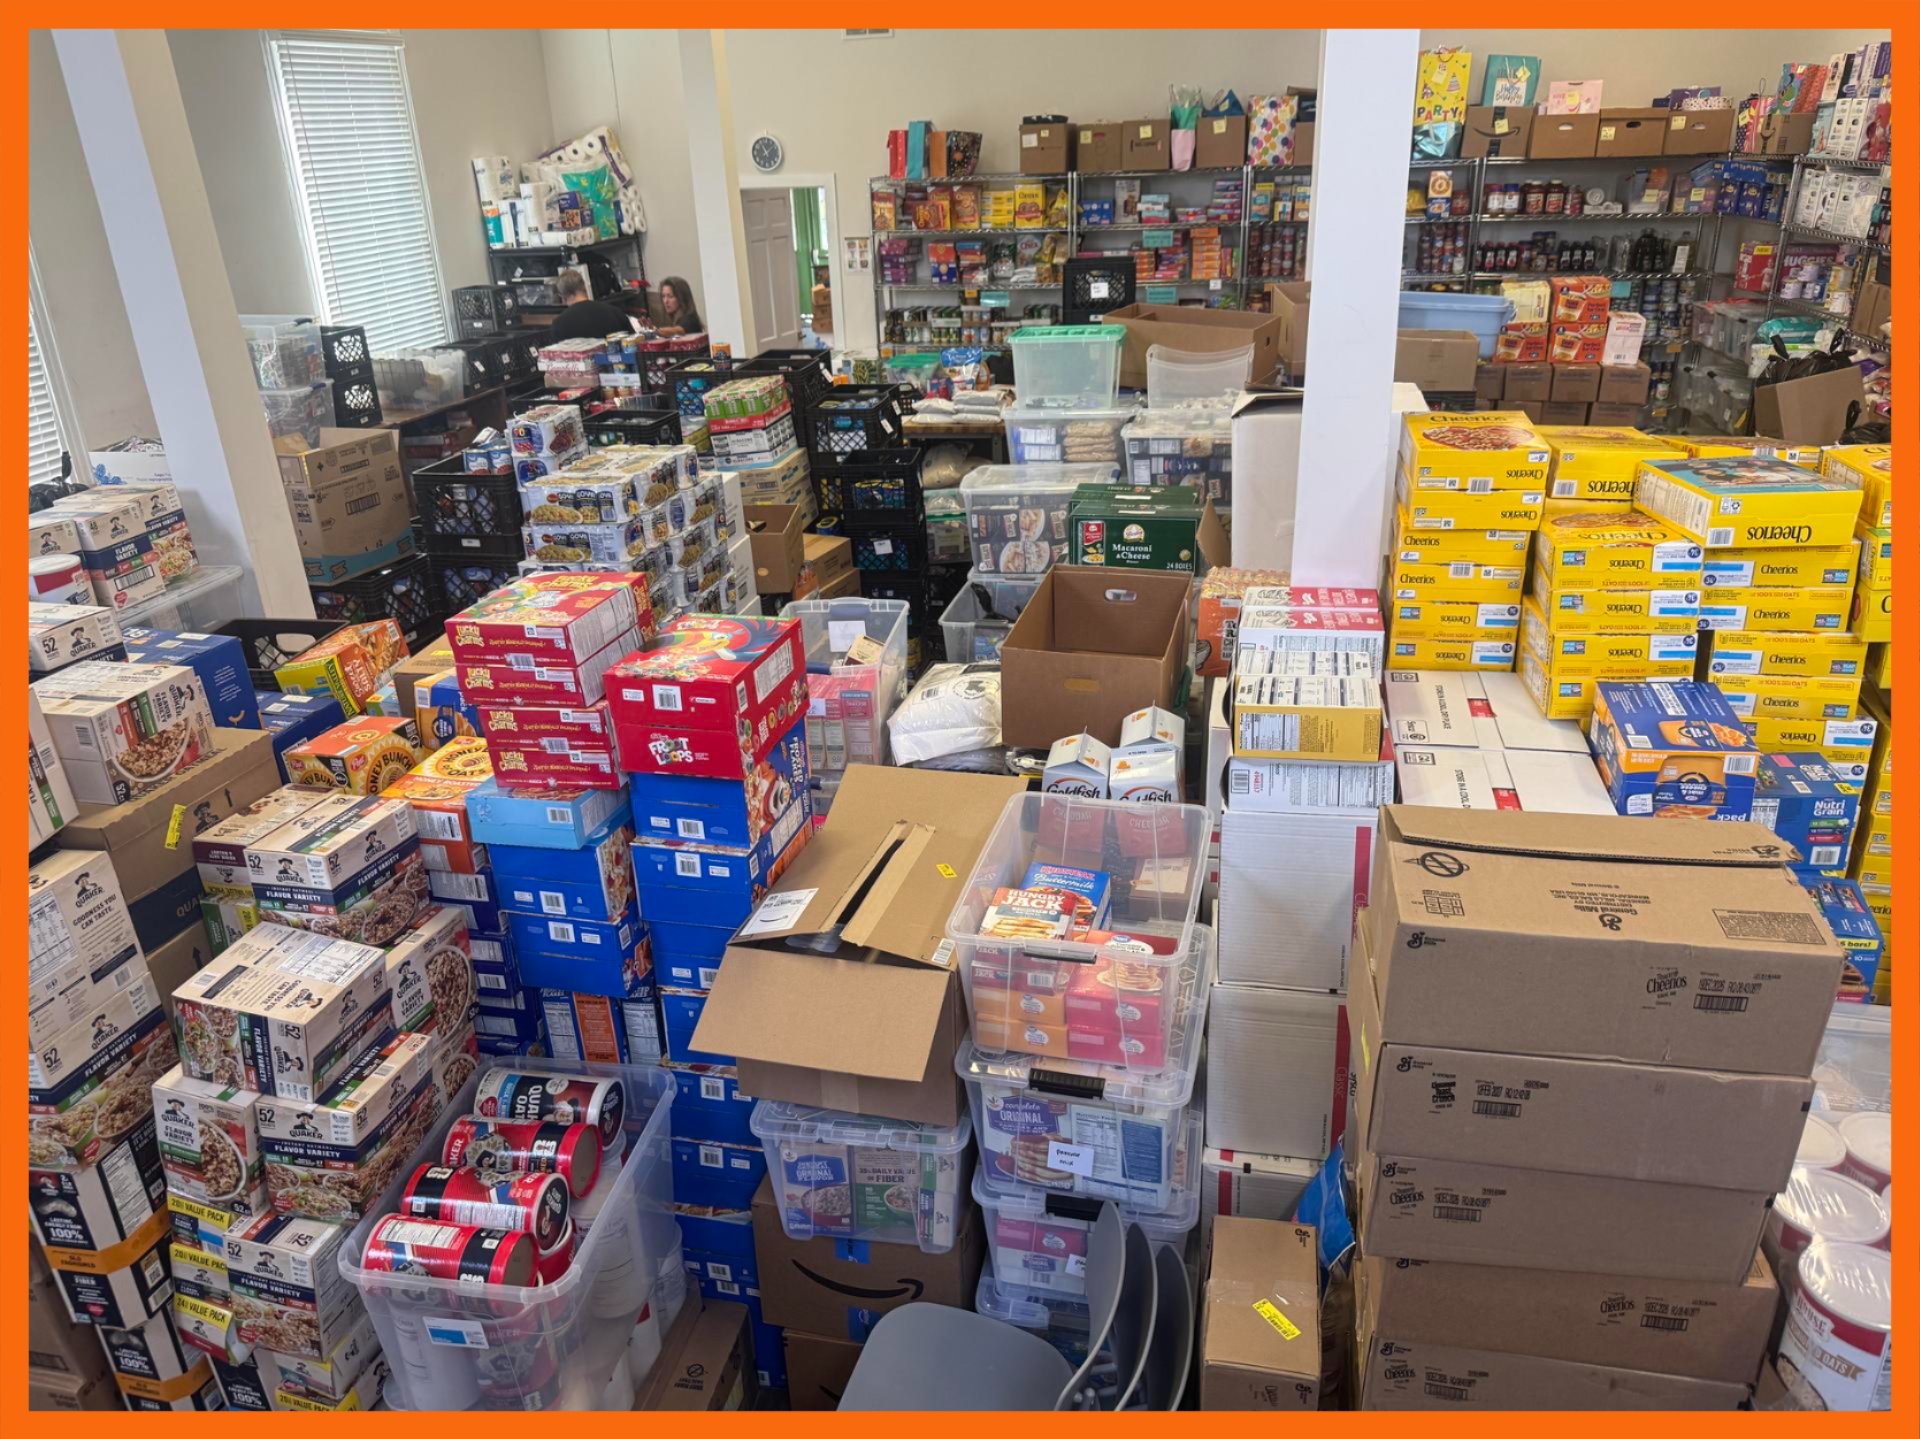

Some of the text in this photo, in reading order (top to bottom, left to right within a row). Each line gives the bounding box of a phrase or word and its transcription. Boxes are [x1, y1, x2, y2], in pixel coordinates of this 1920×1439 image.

[1417, 106, 1462, 121] PARTY!
[1430, 415, 1507, 423] Cheerios
[1506, 469, 1544, 480] Cheerios
[1588, 480, 1637, 497] heerios
[1501, 511, 1537, 521] Cheerios
[110, 527, 129, 539] QUAKER
[1747, 525, 1812, 543] Cheerios
[1404, 536, 1440, 546] Cheerios
[115, 543, 136, 555] FLAVOR
[115, 549, 138, 562] VARIETY
[1112, 544, 1152, 553] Macaroni
[1166, 562, 1192, 570] 24 BOXES
[1610, 559, 1645, 569] Cheerios
[1760, 564, 1798, 575] Cheerios
[1400, 574, 1436, 584] Cheerios
[1607, 603, 1642, 613] Cheerios
[1753, 609, 1790, 620] Cheerios
[1440, 614, 1470, 624] Cheerios
[42, 637, 57, 654] 52
[70, 642, 96, 658] QUAKER
[1435, 652, 1465, 662] Cheerios
[1608, 648, 1643, 658] Cheerios
[1769, 654, 1806, 665] Cheerios
[160, 691, 173, 720] FLAVOR
[169, 684, 182, 717] QUAKER
[1763, 698, 1799, 708] Cheerios
[155, 692, 168, 724] VARIETY
[1780, 731, 1816, 742] Cheerios
[648, 737, 689, 755] FROOT
[656, 751, 694, 767] LOOPS
[792, 737, 804, 783] FROSTED
[1046, 783, 1101, 799] Goldfish
[1814, 807, 1844, 816] Grain
[1815, 800, 1845, 810] Nutri
[1053, 807, 1092, 820] CHEDDAR
[1716, 813, 1746, 822] pack
[1129, 816, 1169, 828] CHEDDAR
[364, 843, 387, 862] QUAKER
[249, 854, 263, 869] 52
[329, 853, 340, 871] 52
[357, 853, 400, 885] FLAVOR VARIETY
[276, 873, 305, 884] QUAKER
[1034, 873, 1095, 890] Buttermilk
[75, 887, 103, 908] QUAKER
[266, 891, 321, 902] FLAVOR VARIETY
[1008, 889, 1065, 902] HUNGRY
[73, 895, 117, 926] GOODNESS YOU
[1001, 896, 1064, 911] JACK
[81, 906, 113, 930] CAN TASTE
[1600, 907, 1638, 915] General
[397, 975, 422, 999] QUAKER
[1646, 976, 1687, 994] Cheerios
[401, 989, 421, 1008] FLAVOR
[401, 996, 424, 1016] VARIETY
[91, 1026, 119, 1050] QUAKER
[284, 1024, 301, 1040] 52
[43, 1047, 61, 1068] 52
[85, 1032, 138, 1077] FLAVOR VARIETY
[274, 1045, 285, 1075] QUAKER
[256, 1055, 267, 1083] VARIETY
[1005, 1101, 1041, 1111] complete
[161, 1113, 195, 1129] QUAKER
[259, 1109, 275, 1123] 52
[356, 1109, 369, 1127] 52
[164, 1125, 193, 1138] FLAVOR
[164, 1131, 194, 1145] VARIETY
[289, 1129, 323, 1140] QUAKER
[274, 1146, 341, 1159] FLAVOR VARIETY
[876, 1174, 905, 1183] FIBER
[1390, 1190, 1424, 1205] Cheerios
[184, 1203, 225, 1223] VALUE PACK
[51, 1228, 83, 1239] 100%
[295, 1233, 313, 1246] 52
[228, 1242, 242, 1257] 52
[187, 1253, 209, 1267] VALUE
[253, 1265, 285, 1279] QUAKER
[241, 1278, 301, 1298] FLAVOR VARIETY
[188, 1301, 225, 1322] VALUE PACK
[1600, 1300, 1634, 1313] Cheerios
[120, 1357, 148, 1369] 100%
[1822, 1354, 1848, 1374] OATS
[1384, 1368, 1416, 1380] Cheerios
[233, 1393, 262, 1405] 100%
[292, 1397, 312, 1411] VALUE
